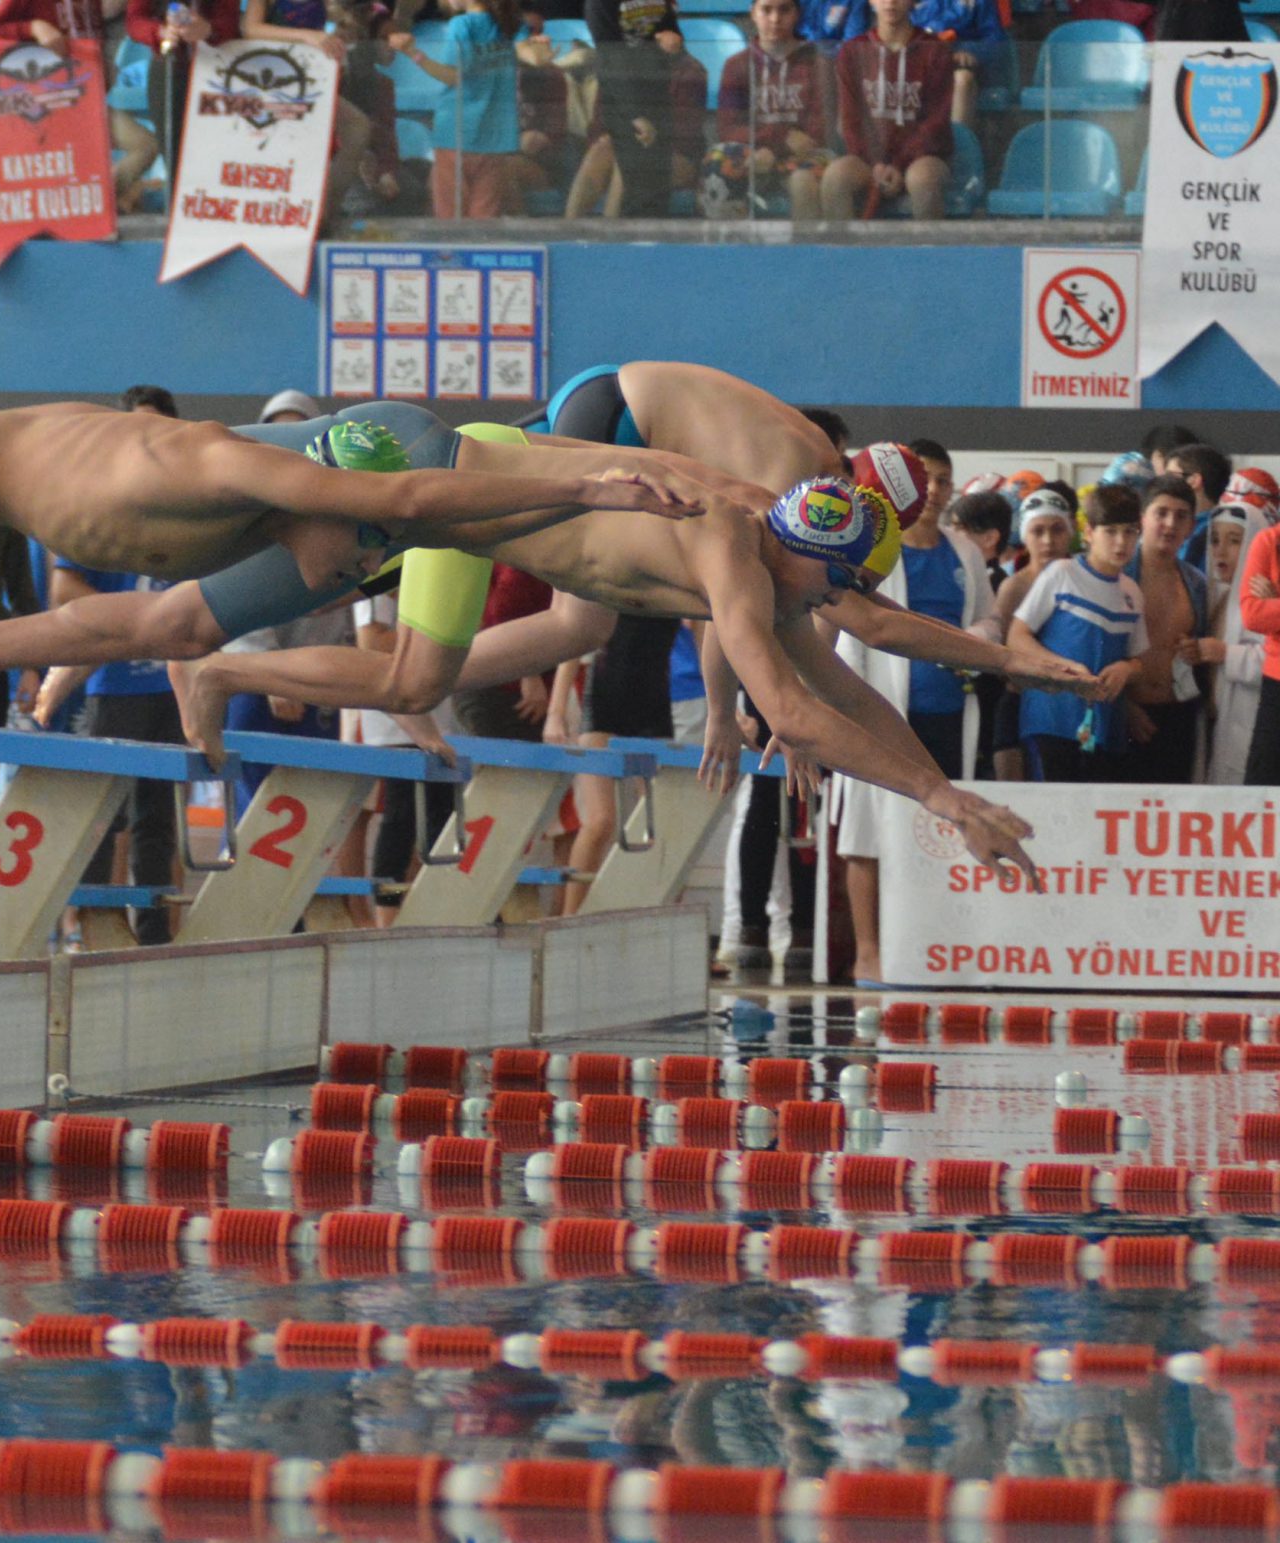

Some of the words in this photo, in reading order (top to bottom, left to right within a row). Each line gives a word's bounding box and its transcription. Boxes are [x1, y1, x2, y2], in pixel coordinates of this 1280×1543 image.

[2, 142, 75, 182] KAYSERİ
[221, 159, 294, 192] KAYSERİ
[37, 175, 104, 220] KULÜBÜ
[183, 189, 239, 222] YÜZME
[242, 197, 313, 230] KULÜBÜ
[1181, 178, 1261, 208] GENÇLİK
[1207, 211, 1231, 231] VE
[1193, 241, 1241, 261] SPOR
[1181, 266, 1257, 293] KULÜBÜ
[1032, 371, 1130, 398] İTMEYİNİZ
[248, 795, 308, 870] 2
[458, 815, 496, 875] 1
[1095, 799, 1277, 858] TÜRKİ
[948, 860, 1109, 895] SPORTİF
[1199, 910, 1246, 938] VE
[926, 943, 1052, 975] SPORA
[1066, 941, 1280, 978] YÖNLENDİR
